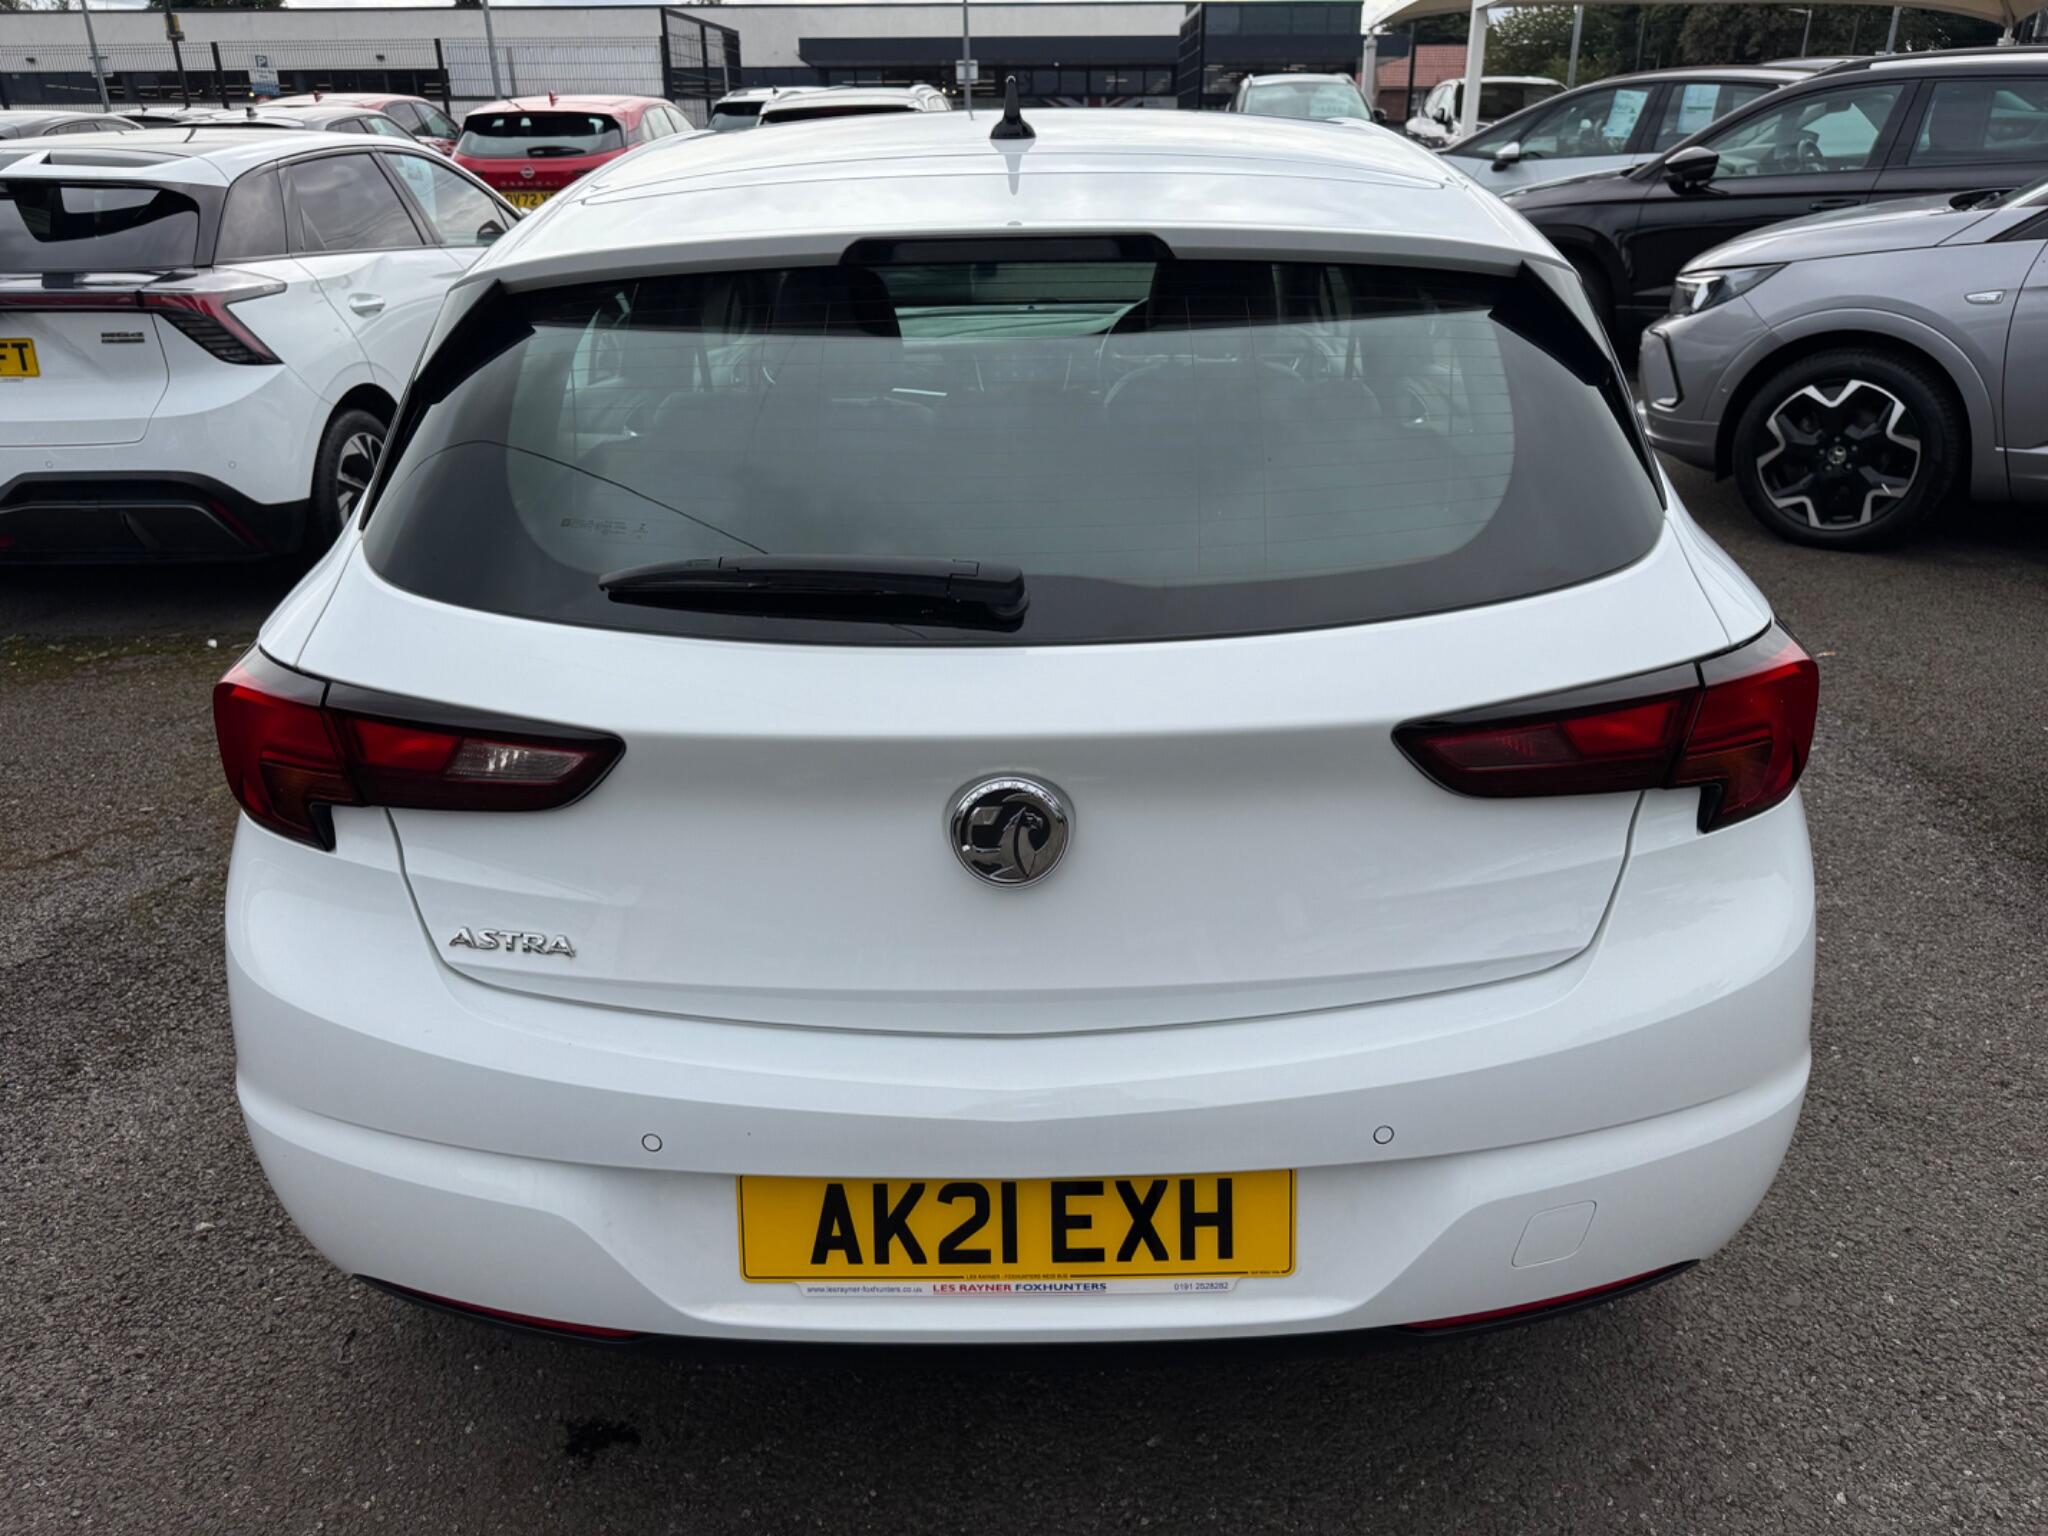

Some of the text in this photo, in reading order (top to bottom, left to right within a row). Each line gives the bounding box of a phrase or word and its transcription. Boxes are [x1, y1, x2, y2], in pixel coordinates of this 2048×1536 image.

[449, 927, 577, 958] ASTRA
[810, 1178, 1233, 1265] AK21 EXH
[933, 1283, 956, 1293] LES
[959, 1283, 1012, 1292] RAYNER
[1015, 1282, 1107, 1292] FOXHUNTERS
[1174, 1283, 1193, 1291] 0191
